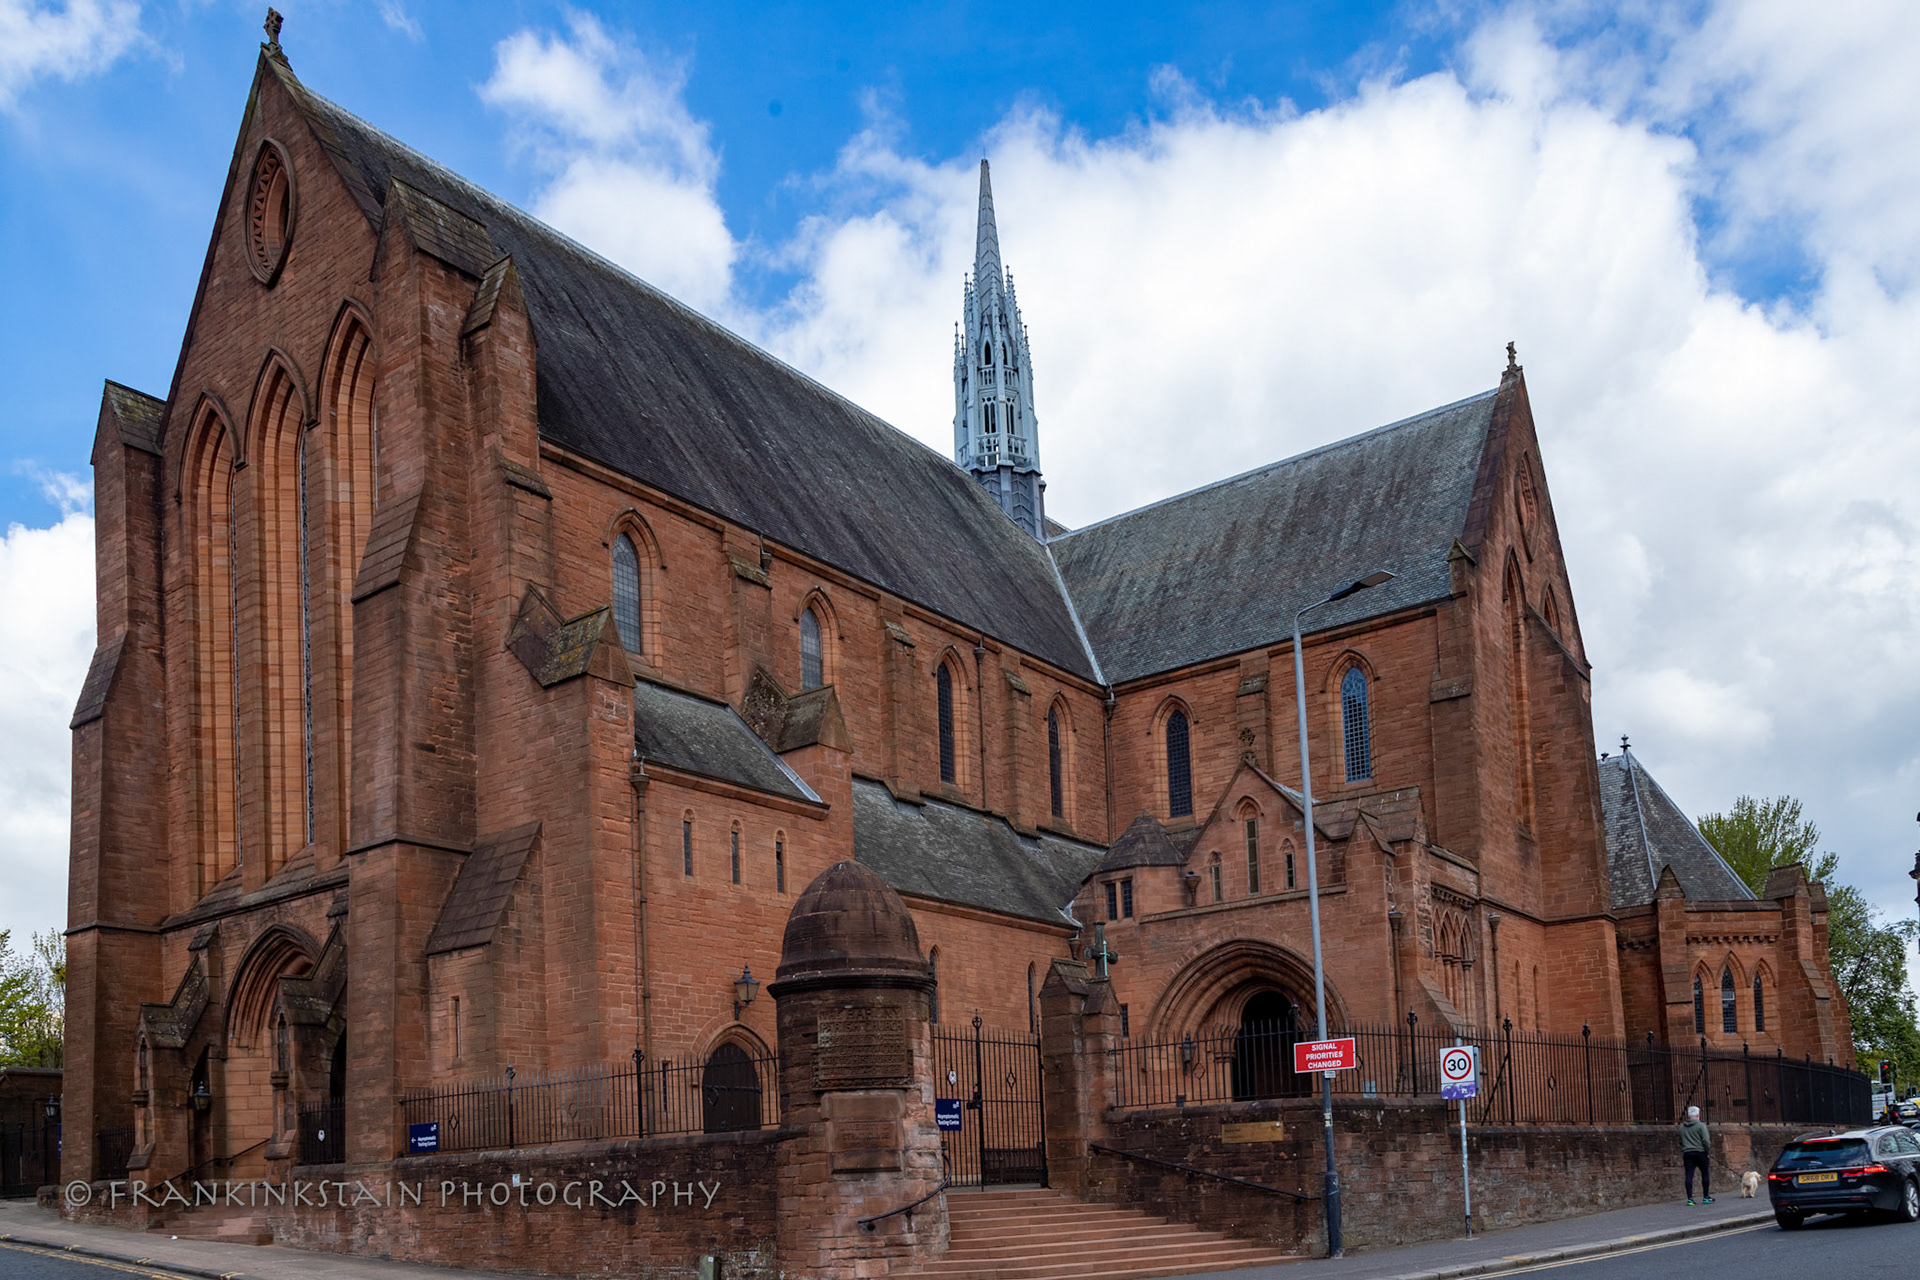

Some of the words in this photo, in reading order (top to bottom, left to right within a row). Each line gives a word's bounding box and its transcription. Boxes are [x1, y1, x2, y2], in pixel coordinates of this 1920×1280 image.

[820, 1021, 859, 1032] PARISH
[864, 1020, 903, 1031] CHURCH
[1311, 1043, 1337, 1051] SIGNAL
[1305, 1051, 1343, 1060] PRIORITIES
[1307, 1060, 1342, 1069] CHANGED
[1447, 1058, 1467, 1071] 30
